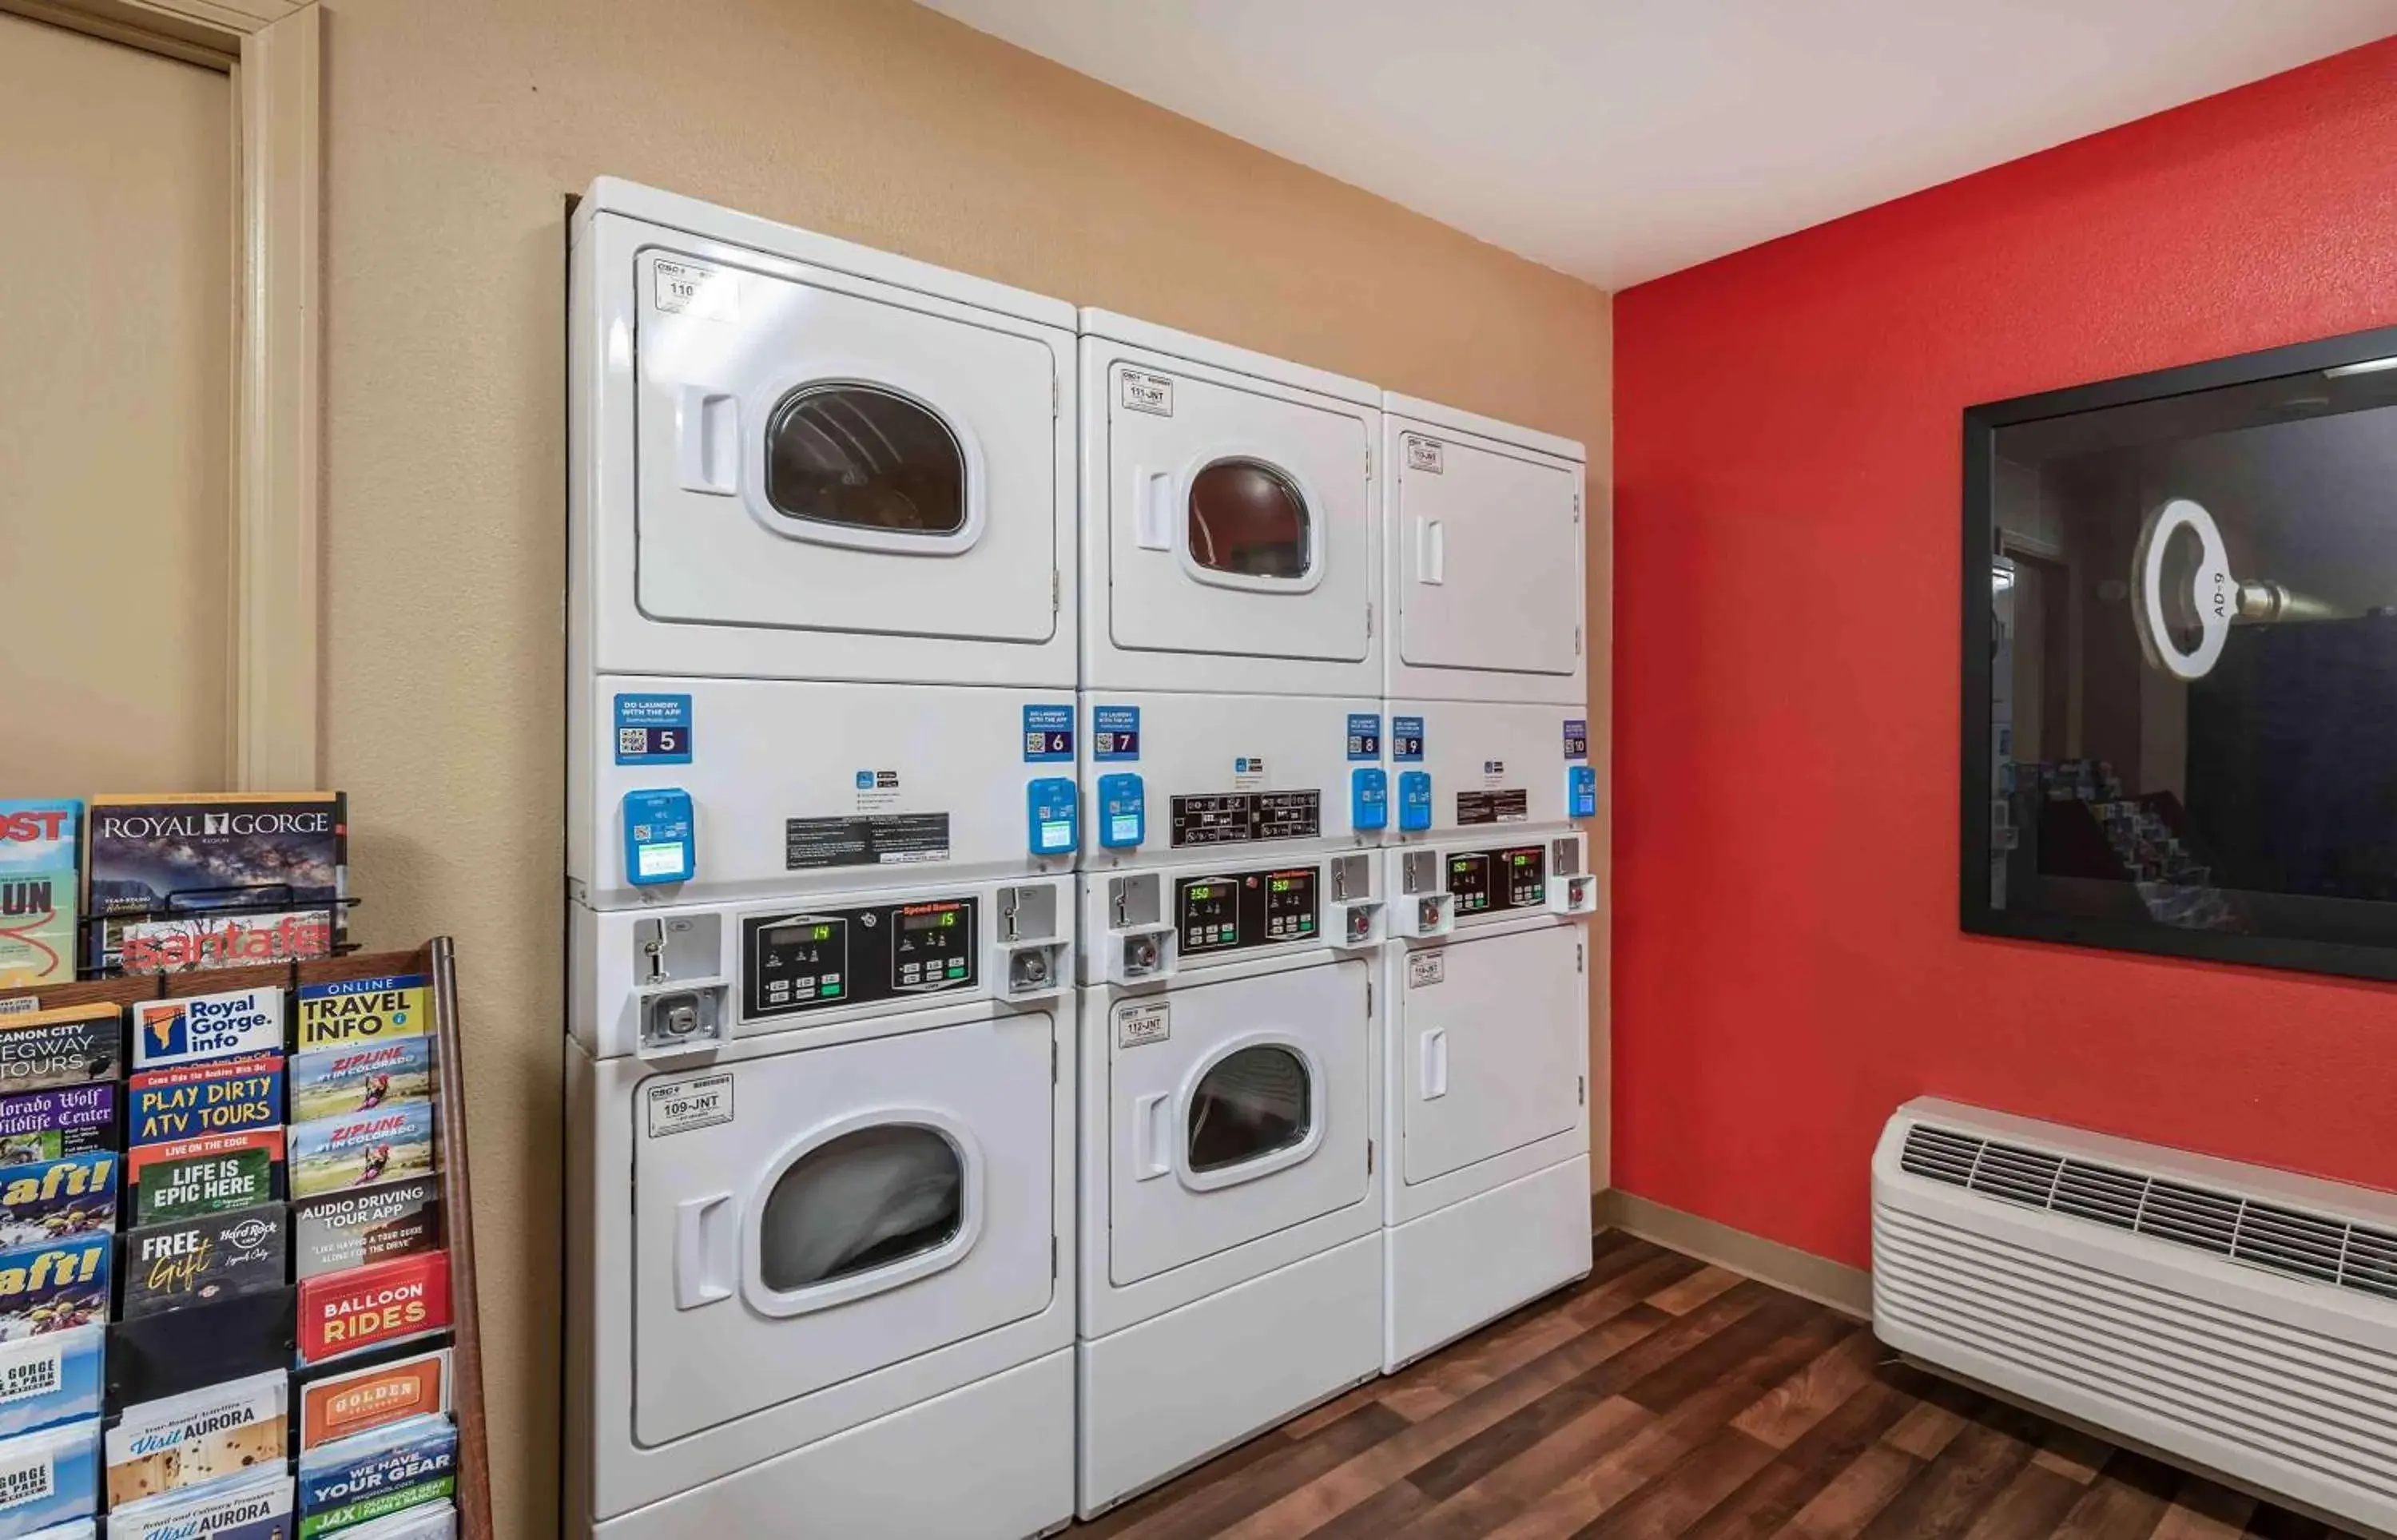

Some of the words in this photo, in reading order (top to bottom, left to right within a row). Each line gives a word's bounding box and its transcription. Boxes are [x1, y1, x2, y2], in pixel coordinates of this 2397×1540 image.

[2214, 573, 2224, 617] AD-9
[660, 731, 675, 751] 5
[1053, 734, 1063, 751] 6
[1120, 734, 1131, 751] 7
[1365, 738, 1373, 752] 8
[1409, 740, 1417, 753] 9
[1575, 740, 1584, 752] 10
[104, 816, 200, 839] ROYAL
[232, 813, 328, 835] GORGE
[813, 926, 829, 939] 14
[942, 913, 954, 927] 15
[328, 978, 393, 994] ONLINE
[190, 994, 255, 1018] Royal
[304, 992, 411, 1020] TRAVEL
[51, 1024, 85, 1037] CITY
[191, 1014, 272, 1034] Gorge.
[307, 1015, 383, 1042] INFO
[2, 1035, 94, 1062] EGWAY
[192, 1033, 239, 1052] info
[0, 1054, 84, 1078] TOURS
[332, 1046, 405, 1072] ZIPLINE
[332, 1069, 347, 1080] IN
[348, 1054, 415, 1075] COLORADO
[58, 1088, 103, 1109] Wolf
[142, 1086, 199, 1113] PLAY
[208, 1076, 271, 1104] DIRTY
[665, 1095, 719, 1116] 109-JNT
[0, 1113, 50, 1134] ildlife
[58, 1108, 111, 1125] Center
[142, 1113, 189, 1138] ATV
[198, 1101, 271, 1129] TOURS
[332, 1115, 406, 1142] ZIPLINE
[165, 1146, 188, 1157] LIVE
[189, 1143, 202, 1152] ON
[205, 1141, 221, 1150] THE
[224, 1137, 248, 1147] EDGE
[332, 1138, 346, 1151] IN
[348, 1124, 415, 1146] COLORADO
[0, 1160, 113, 1206] aft!
[173, 1163, 216, 1186] LIFE
[220, 1159, 239, 1177] IS
[154, 1185, 200, 1208] EPIC
[205, 1174, 255, 1199] HERE
[302, 1201, 355, 1220] AUDIO
[359, 1186, 424, 1209] DRIVING
[324, 1213, 368, 1229] TOUR
[372, 1204, 403, 1221] APP
[220, 1225, 248, 1241] Hard
[249, 1221, 279, 1236] Rock
[141, 1229, 200, 1262] FREE
[369, 1244, 384, 1254] THE
[148, 1236, 213, 1293] Gift
[324, 1283, 423, 1318] BALLOON
[324, 1300, 427, 1344] RIDES
[8, 1359, 55, 1380] GORGE
[23, 1372, 54, 1386] PARK
[336, 1383, 412, 1413] GOLDEN
[130, 1428, 183, 1455] Visit
[184, 1407, 255, 1441] AURORA
[0, 1464, 46, 1488] GORGE
[350, 1466, 376, 1478] WE
[378, 1452, 421, 1472] HAVE
[14, 1478, 46, 1494] PARK
[315, 1474, 383, 1502] YOUR
[388, 1454, 451, 1481] GEAR
[145, 1520, 197, 1540] Visit
[199, 1501, 271, 1534] AURORA
[316, 1506, 356, 1530] JAX
